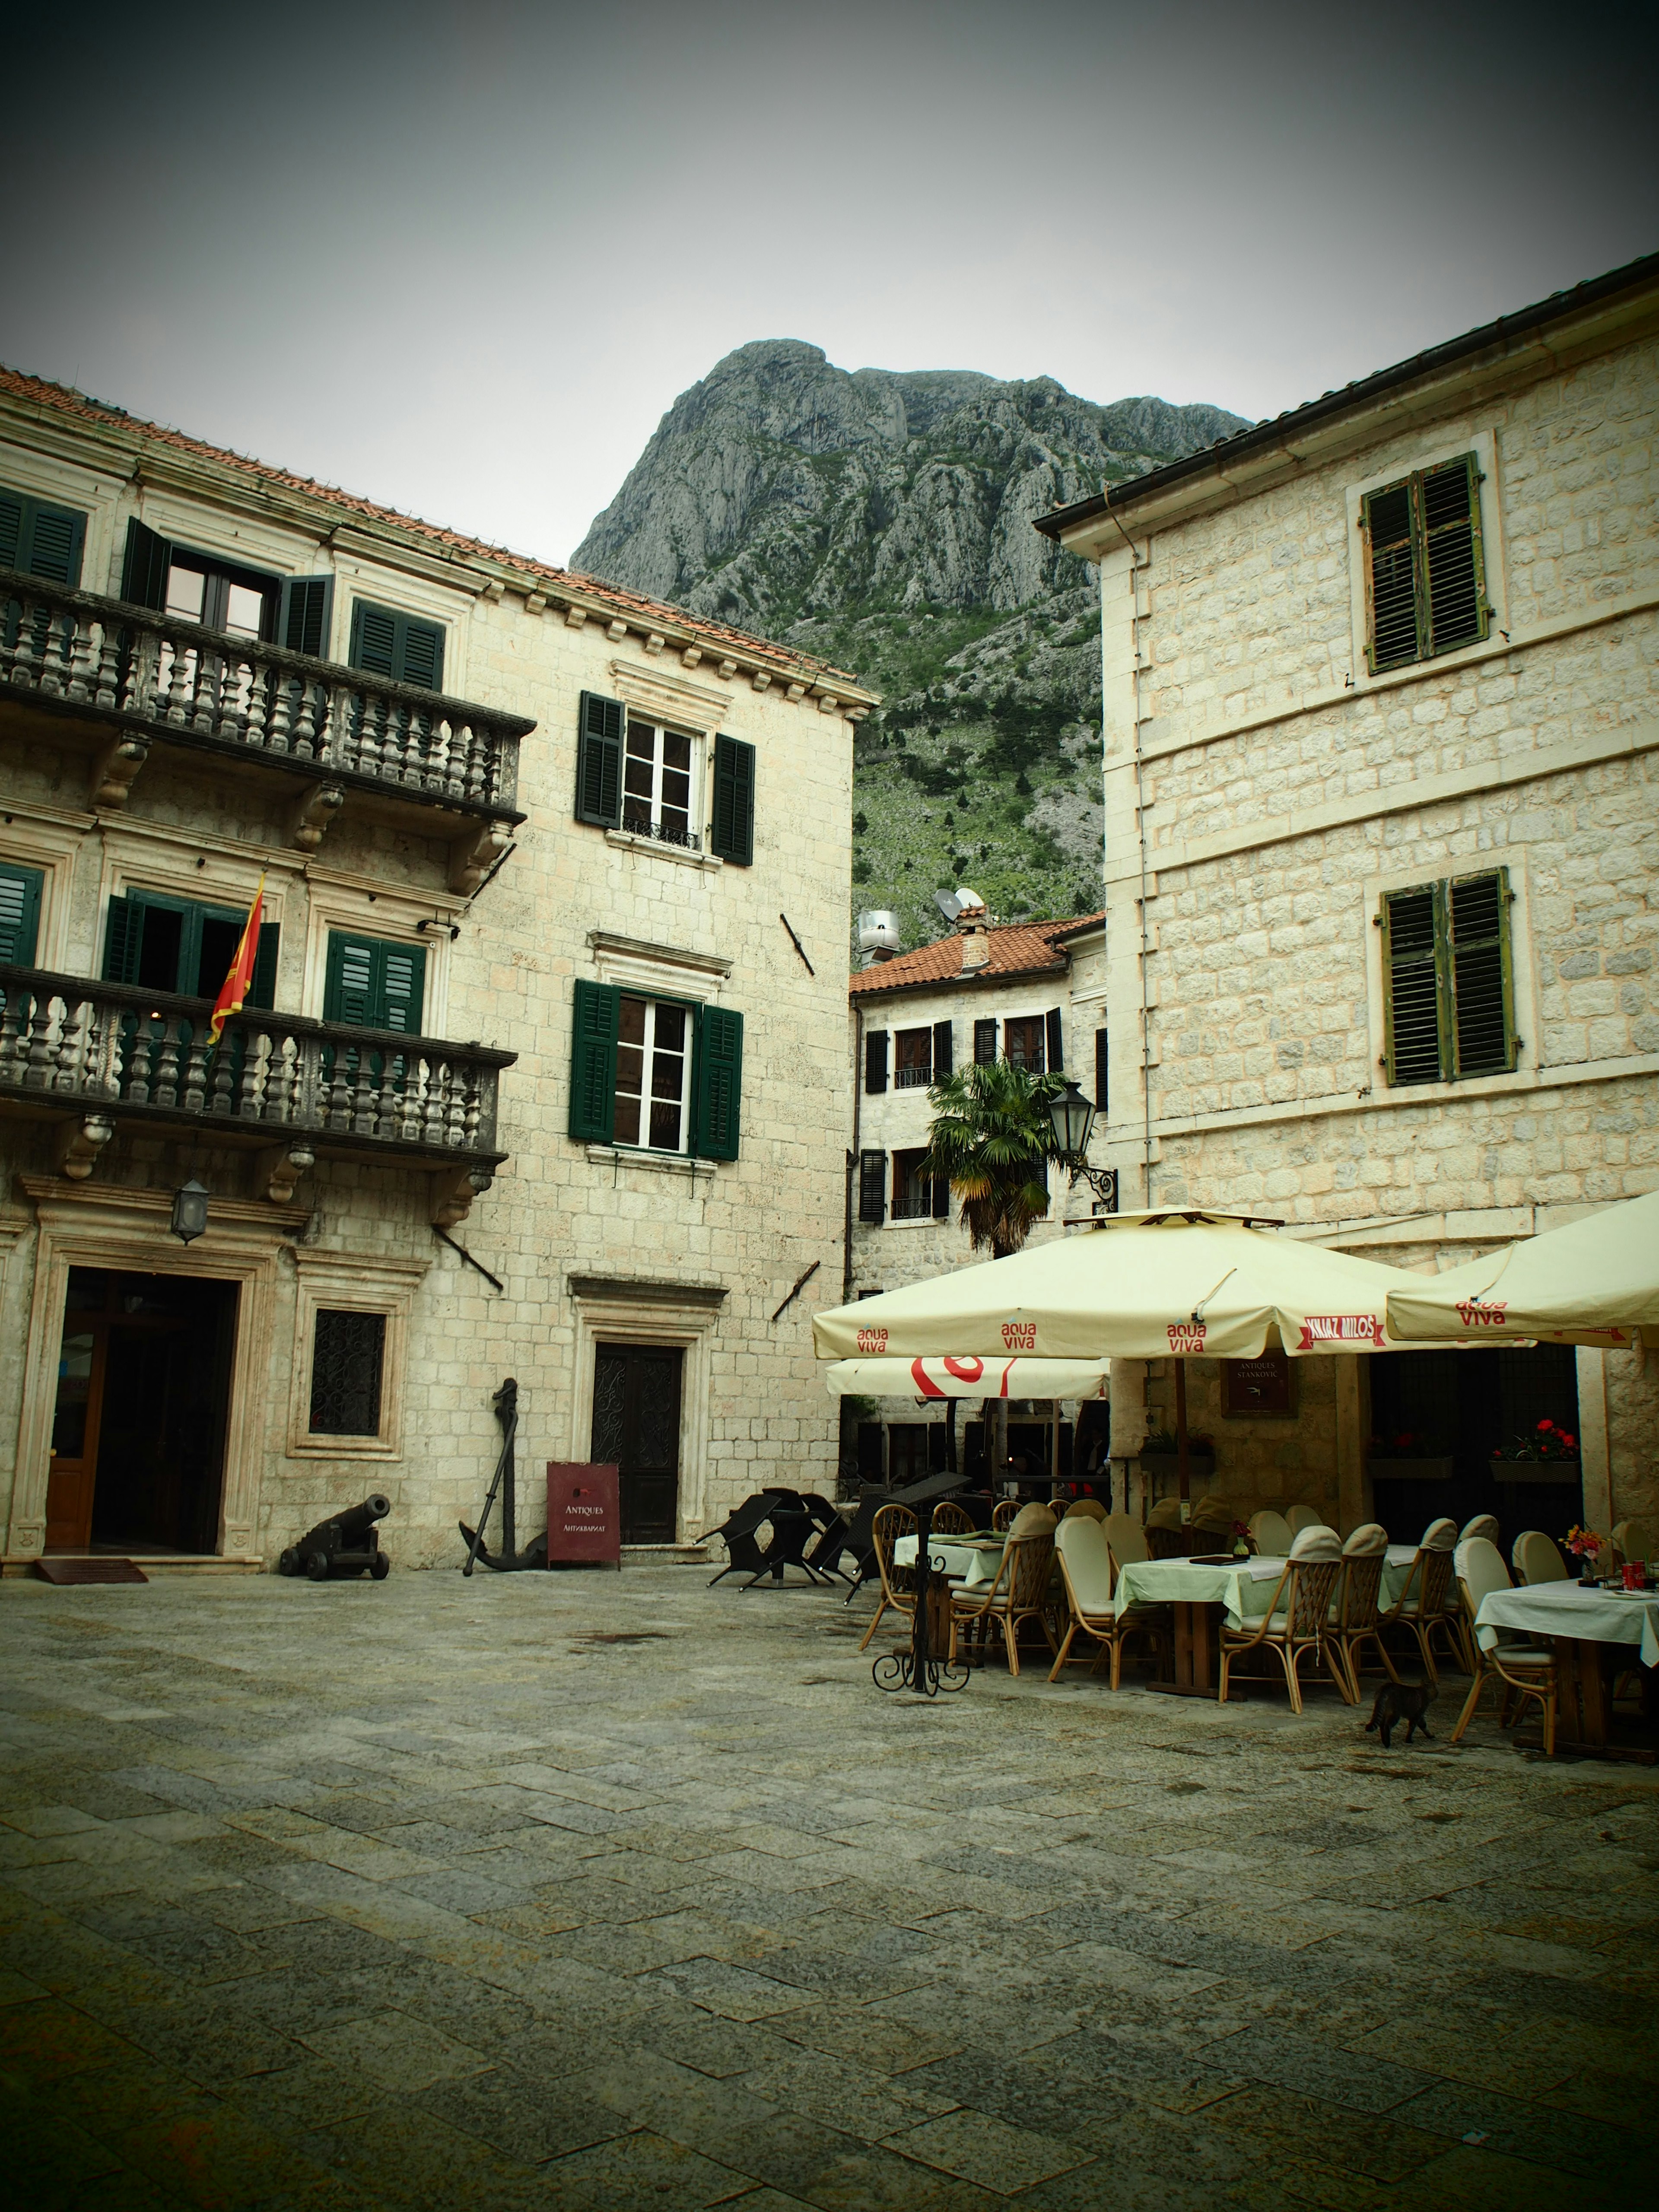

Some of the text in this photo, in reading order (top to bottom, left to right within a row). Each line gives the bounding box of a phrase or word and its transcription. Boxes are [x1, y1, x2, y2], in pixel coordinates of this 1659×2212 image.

[1460, 1311, 1506, 1325] viva
[1001, 1323, 1036, 1335] aqua
[1167, 1325, 1207, 1338] aqua
[1306, 1315, 1374, 1339] KNJAZ MILOŠ
[857, 1328, 888, 1340] aqua
[858, 1341, 886, 1352] viva
[1004, 1337, 1034, 1349] viva
[1170, 1339, 1204, 1352] viva
[565, 1505, 604, 1516] ANTIQUES
